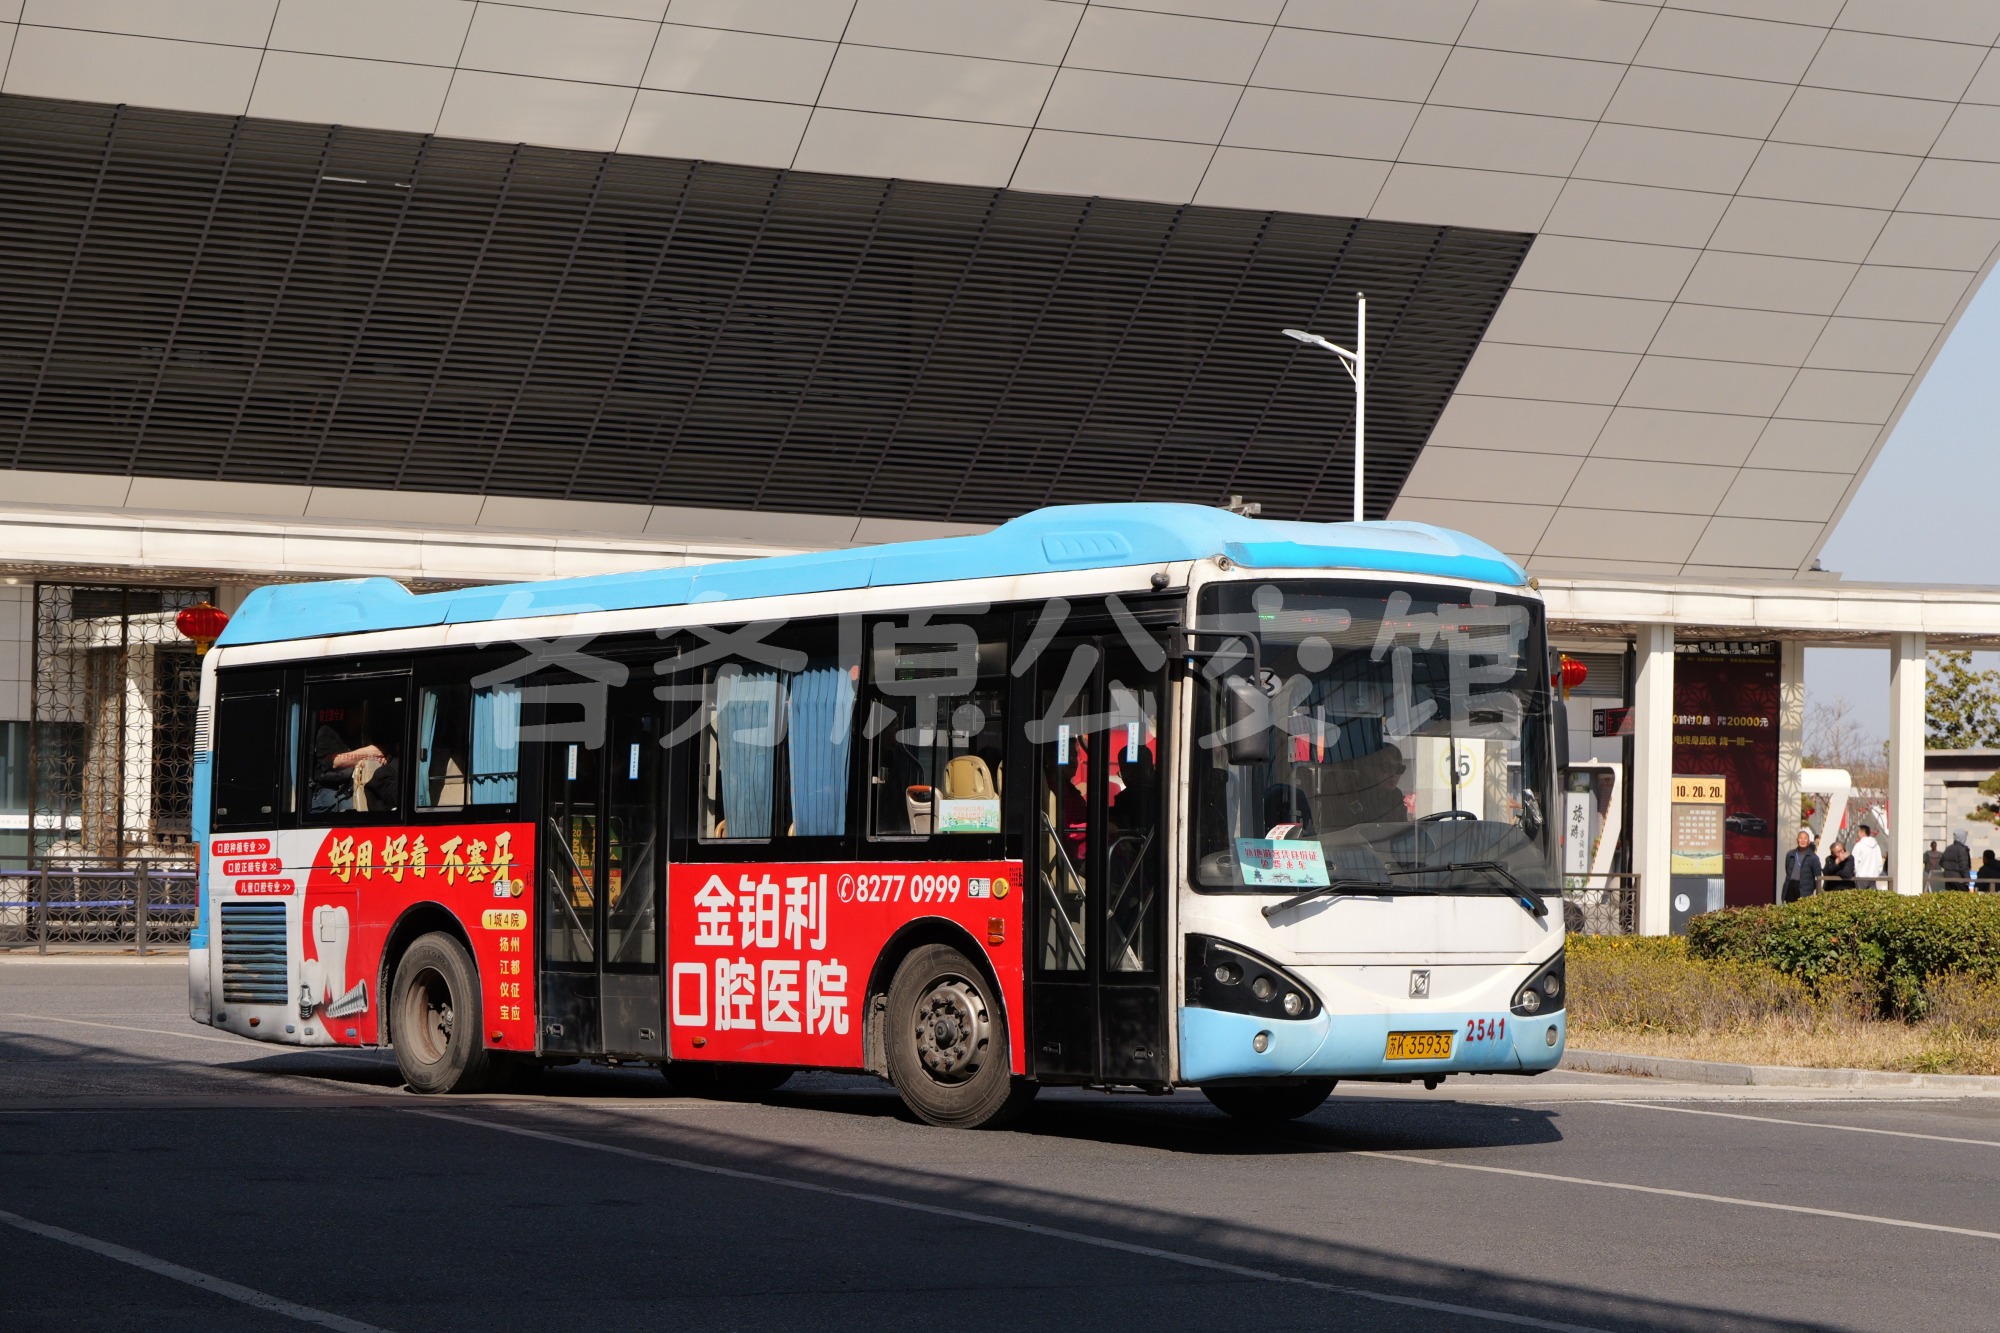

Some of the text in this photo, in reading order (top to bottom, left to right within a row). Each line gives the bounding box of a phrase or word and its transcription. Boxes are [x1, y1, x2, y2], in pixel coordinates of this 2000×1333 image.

[217, 841, 256, 853] 口腔种植专业
[327, 834, 373, 883] 好用
[381, 833, 429, 885] 好看
[438, 830, 514, 886] 不塞牙
[228, 861, 268, 873] 口腔正畸专业
[240, 881, 281, 893] 儿童口腔专业
[856, 874, 906, 903] 8277
[909, 874, 961, 903] 0999
[693, 874, 828, 950] 金铂利
[499, 936, 520, 953] 扬州
[499, 959, 521, 975] 江都
[500, 982, 520, 998] 仪征
[672, 956, 850, 1036] 口腔医院
[500, 1005, 521, 1021] 宝应
[1466, 1017, 1505, 1042] 2541
